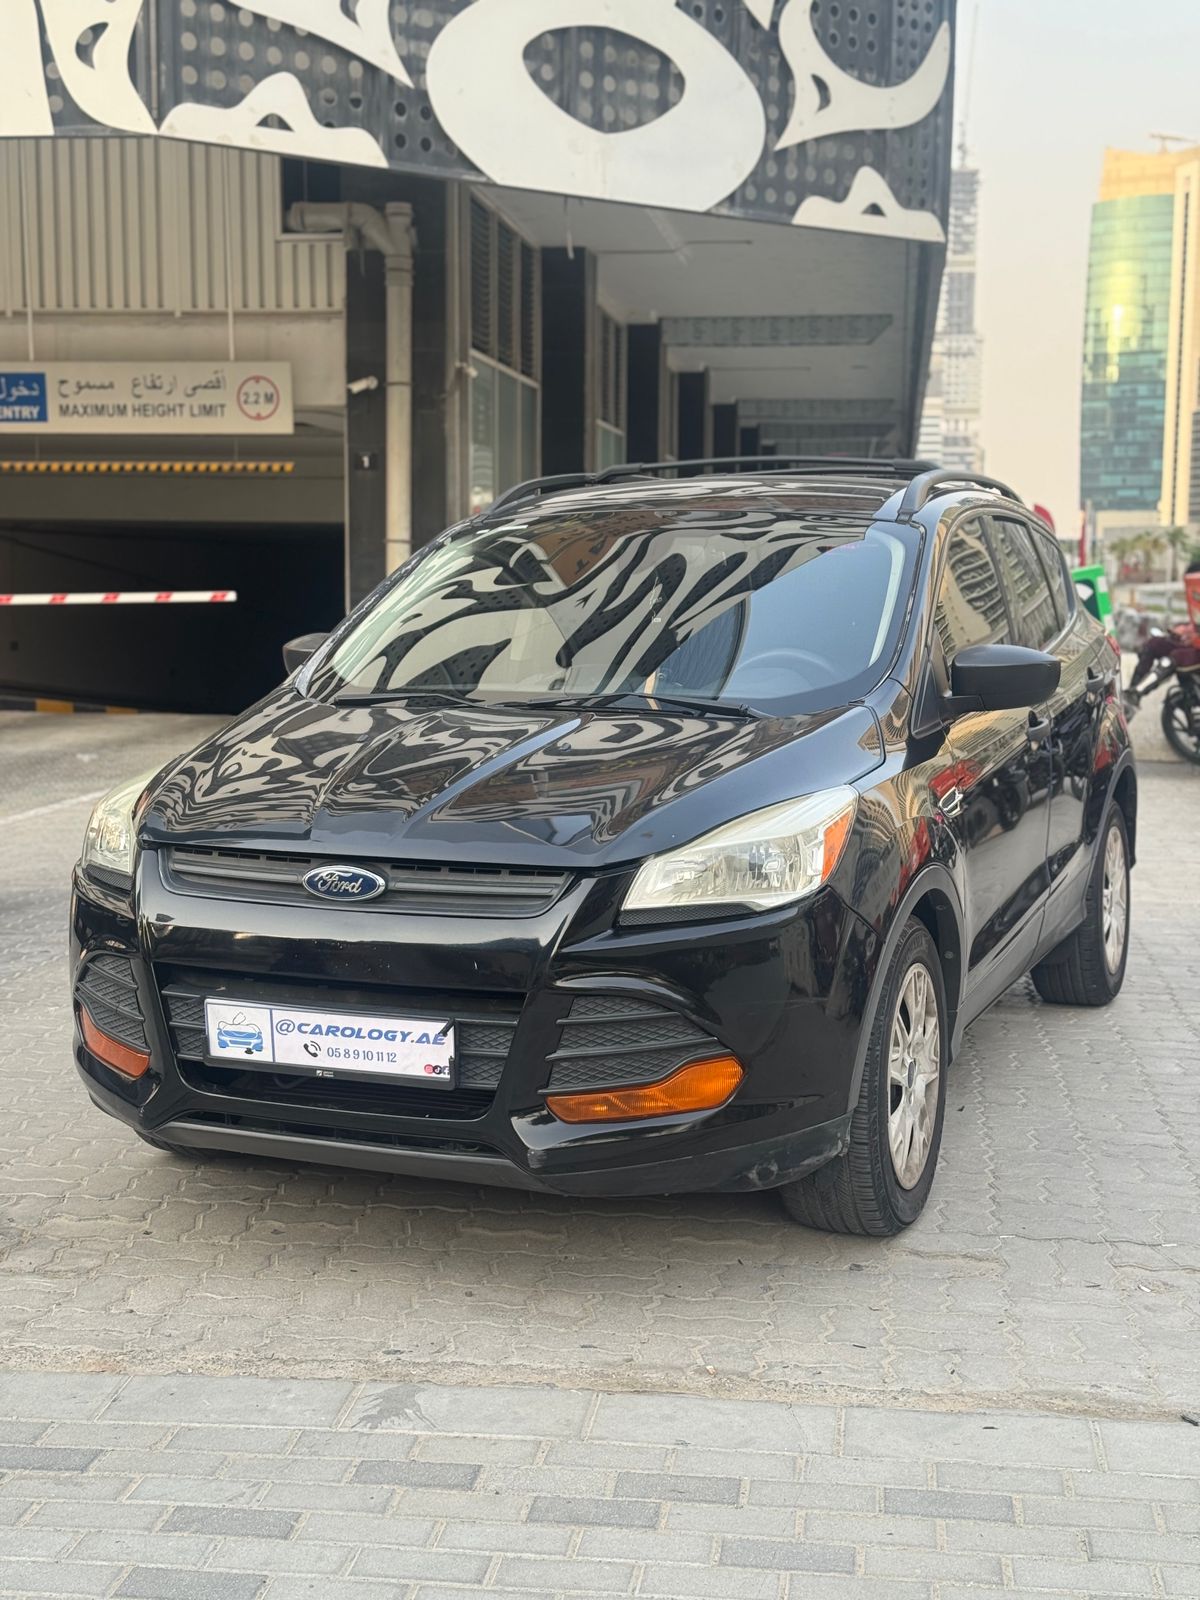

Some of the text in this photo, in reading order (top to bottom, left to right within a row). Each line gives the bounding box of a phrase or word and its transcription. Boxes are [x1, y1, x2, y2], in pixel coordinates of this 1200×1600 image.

[57, 378, 115, 398] مسموح
[263, 391, 275, 405] M
[58, 403, 227, 418] MAXIMUM HEIGHT LIMIT
[313, 870, 363, 894] Ford
[275, 1019, 446, 1046] @CAROLOGY.AE
